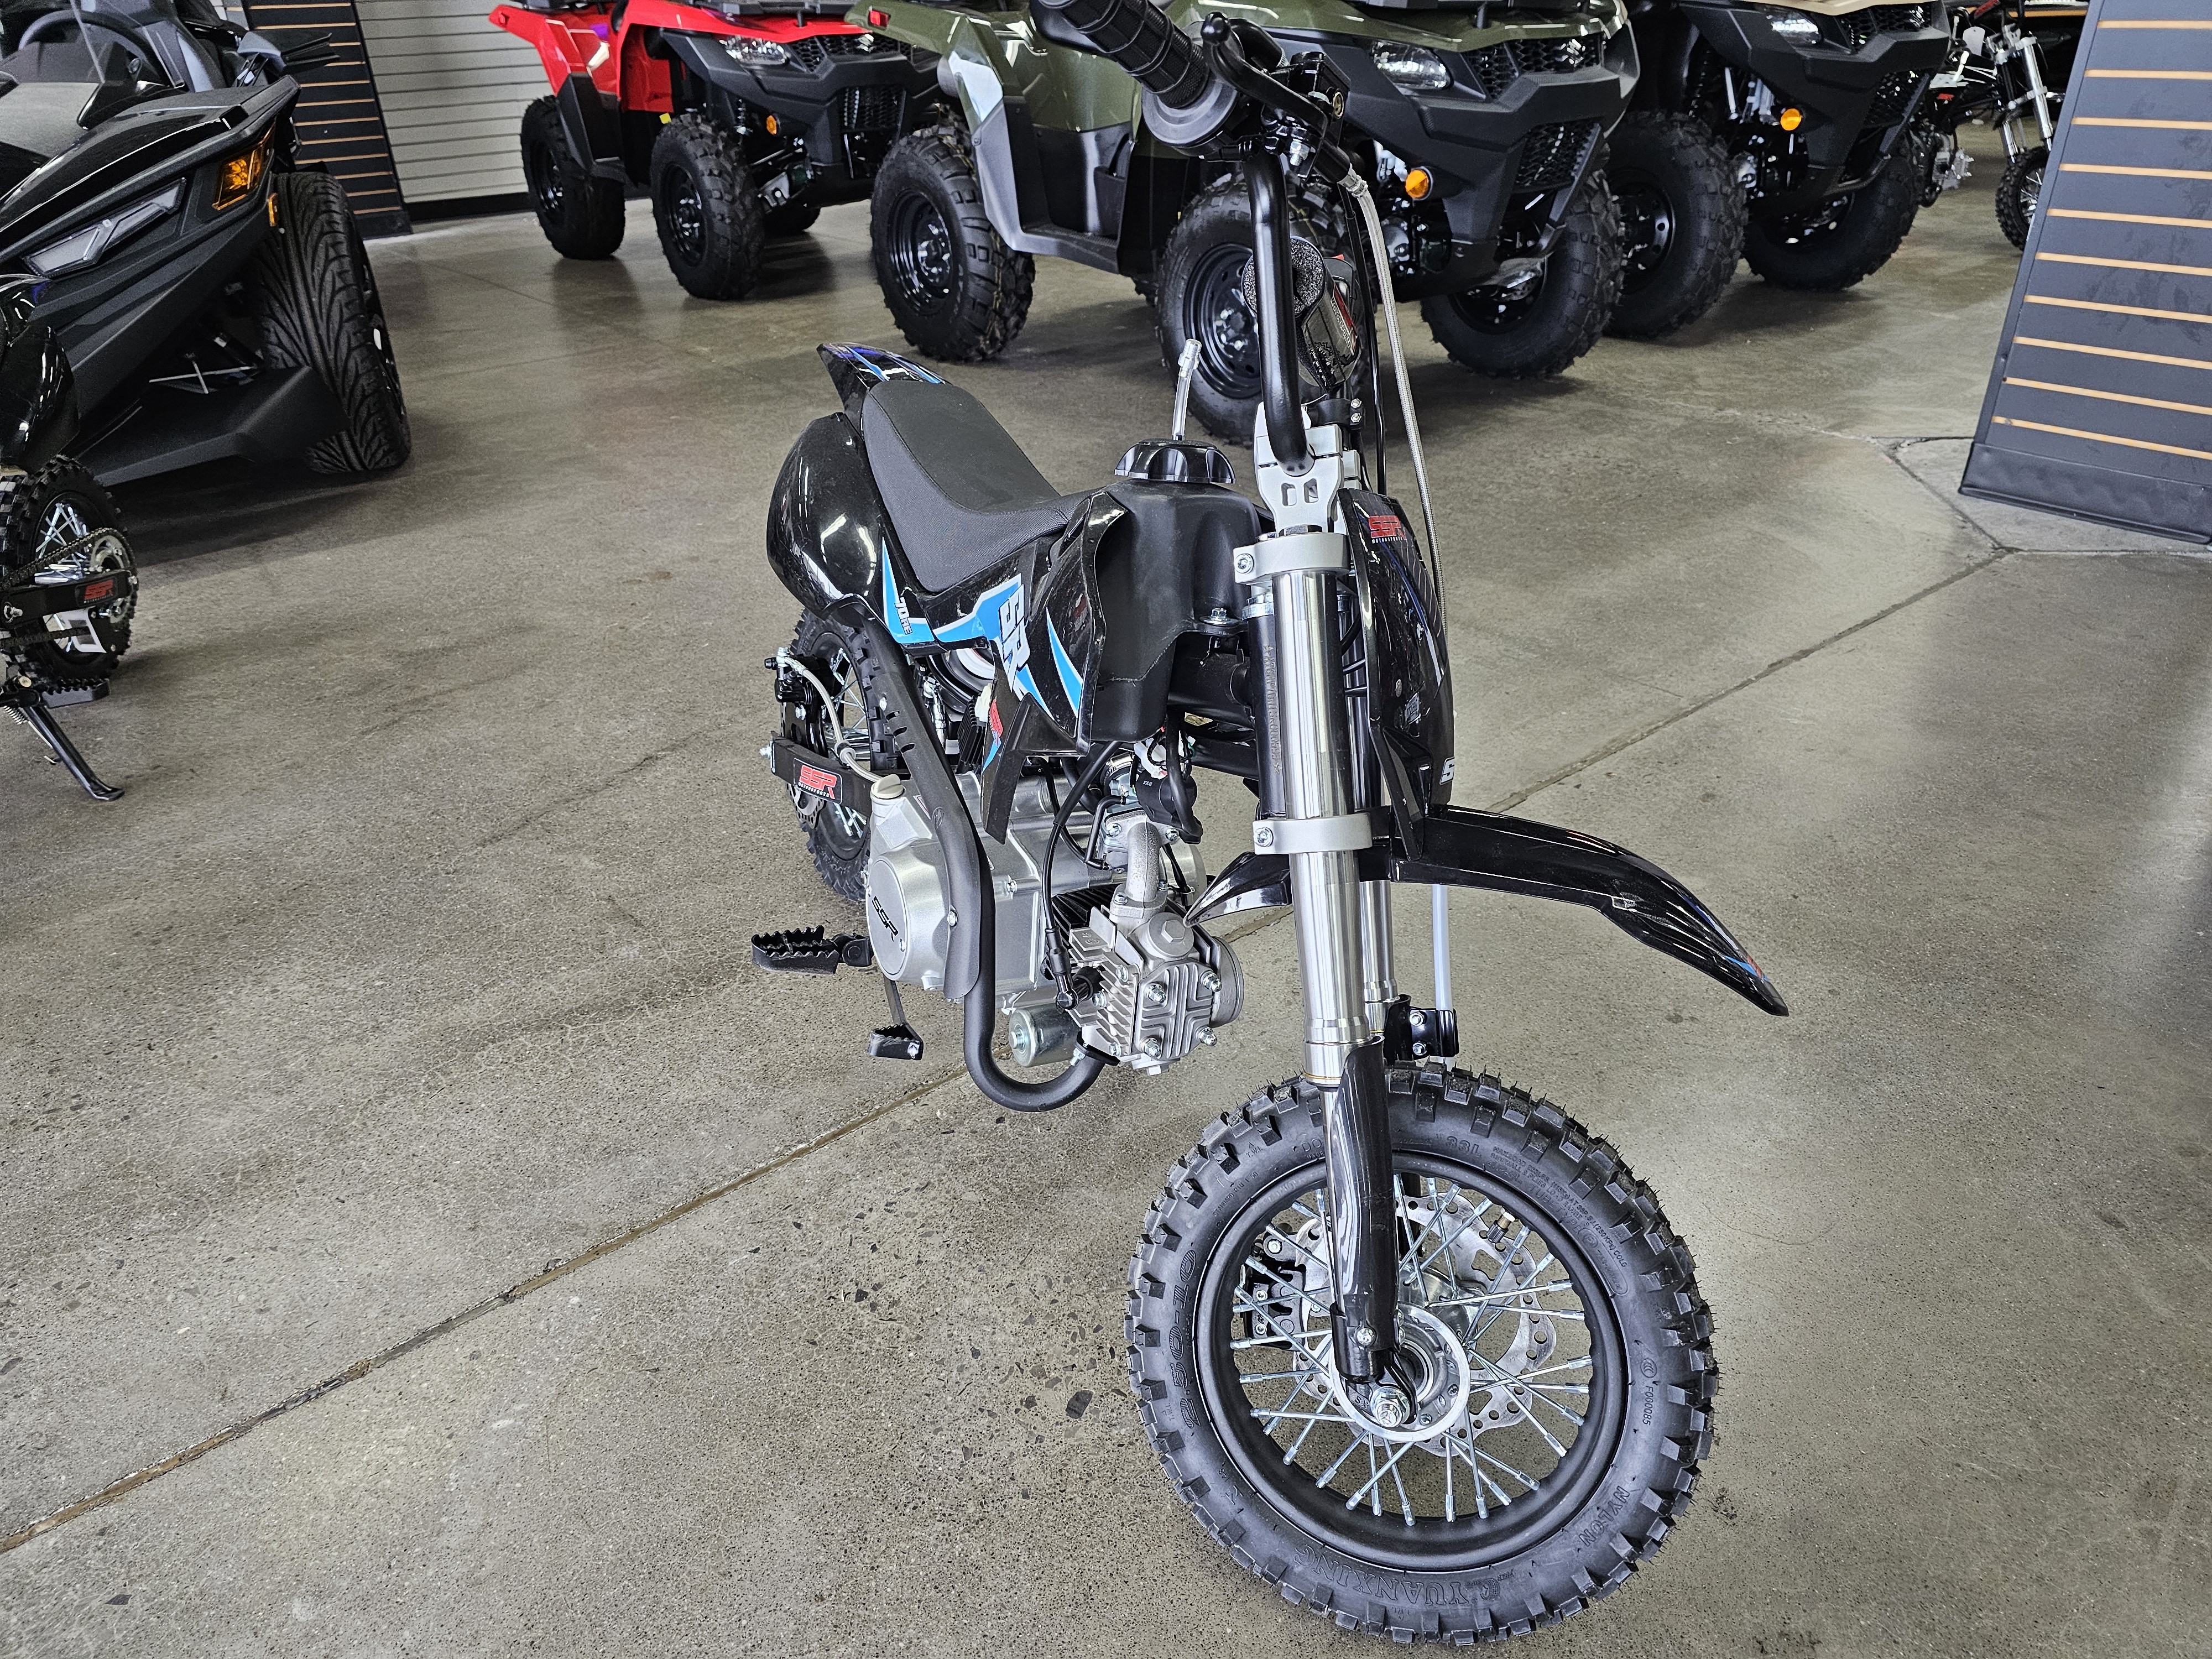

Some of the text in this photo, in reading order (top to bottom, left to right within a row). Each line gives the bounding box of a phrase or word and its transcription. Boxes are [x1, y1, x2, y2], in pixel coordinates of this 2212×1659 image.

[1369, 515, 1407, 540] SSR
[799, 764, 836, 800] SSR
[872, 896, 899, 942] SSR
[1168, 1249, 1201, 1430] 2.50-10
[1641, 1385, 1654, 1425] F000085
[1577, 1484, 1632, 1547] NYLON
[1291, 1542, 1471, 1605] YUANXING
